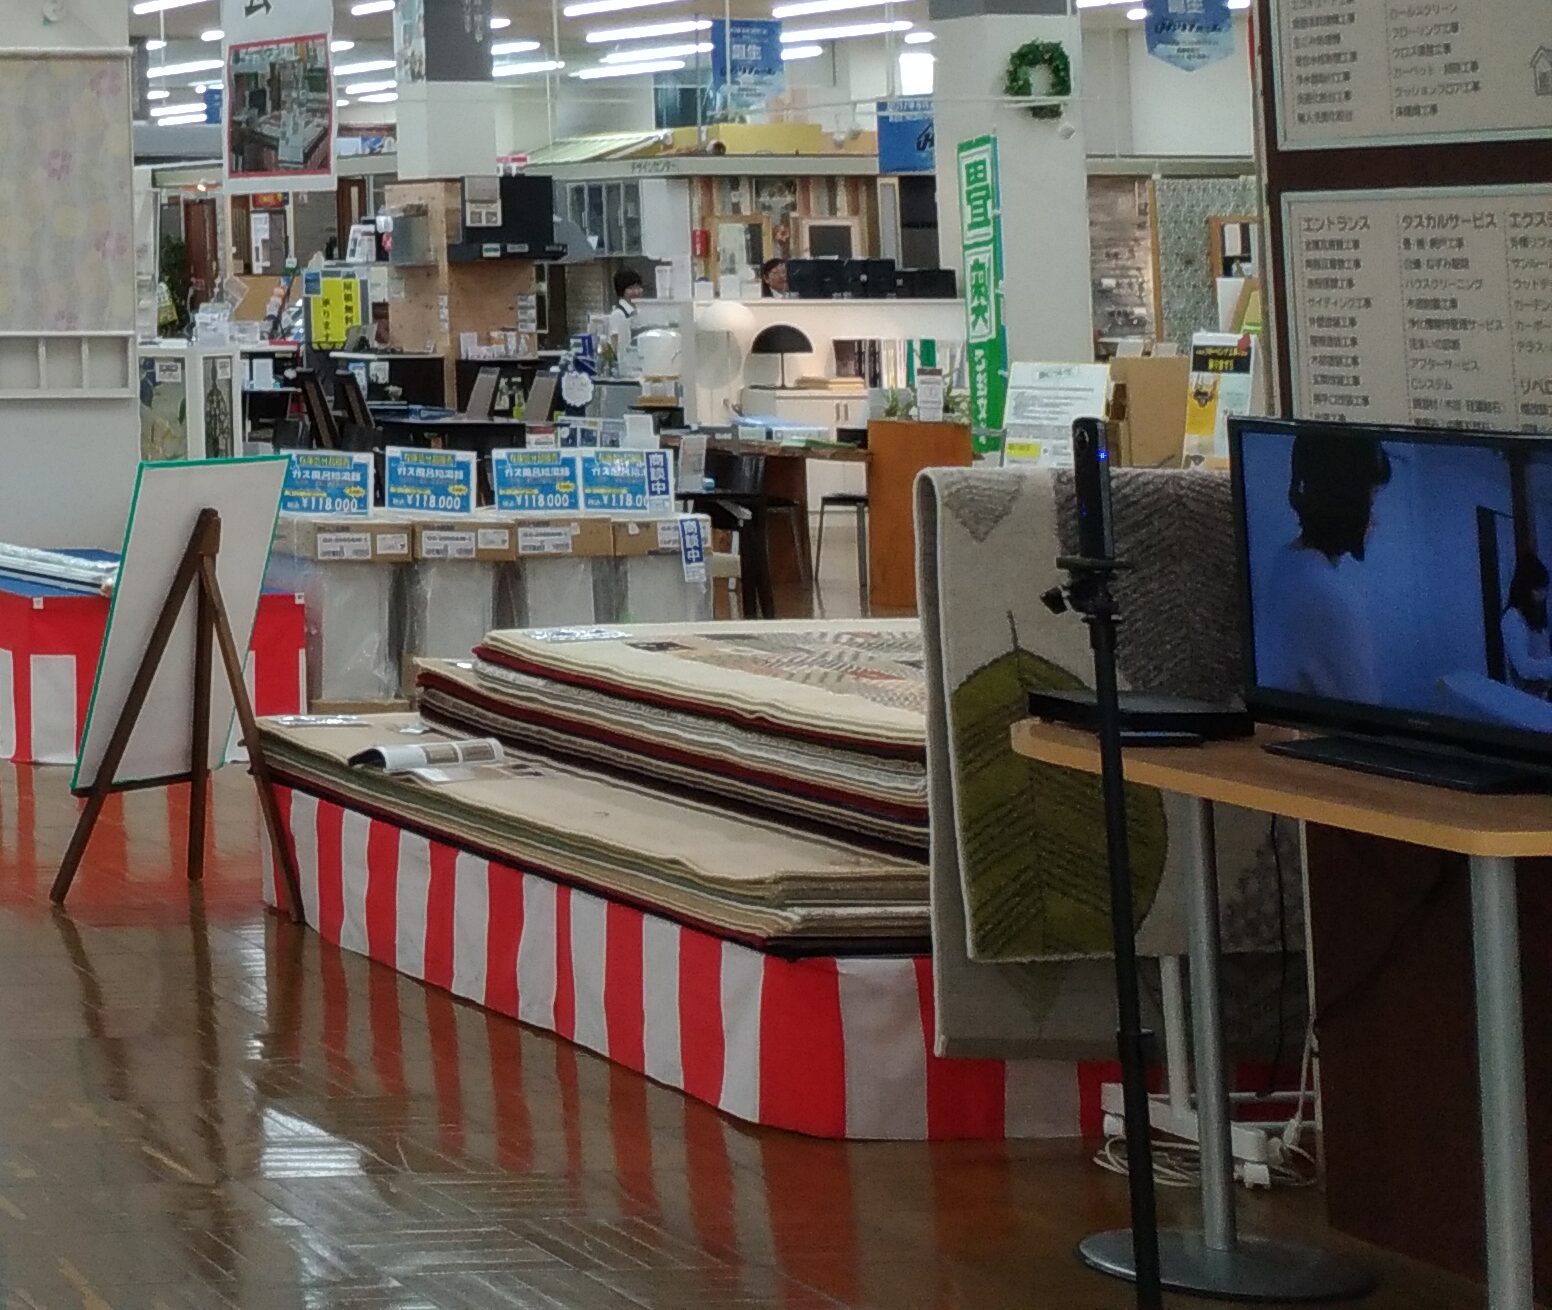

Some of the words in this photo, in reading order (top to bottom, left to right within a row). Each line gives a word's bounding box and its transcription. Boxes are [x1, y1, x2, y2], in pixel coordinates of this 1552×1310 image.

[1302, 215, 1371, 232] エントランス
[1401, 213, 1497, 230] タスカルサービス
[1405, 278, 1484, 290] ハウスクリーニング
[1307, 296, 1372, 310] サイディング工事
[1409, 358, 1480, 372] アフターサービス
[649, 453, 667, 496] 商談中
